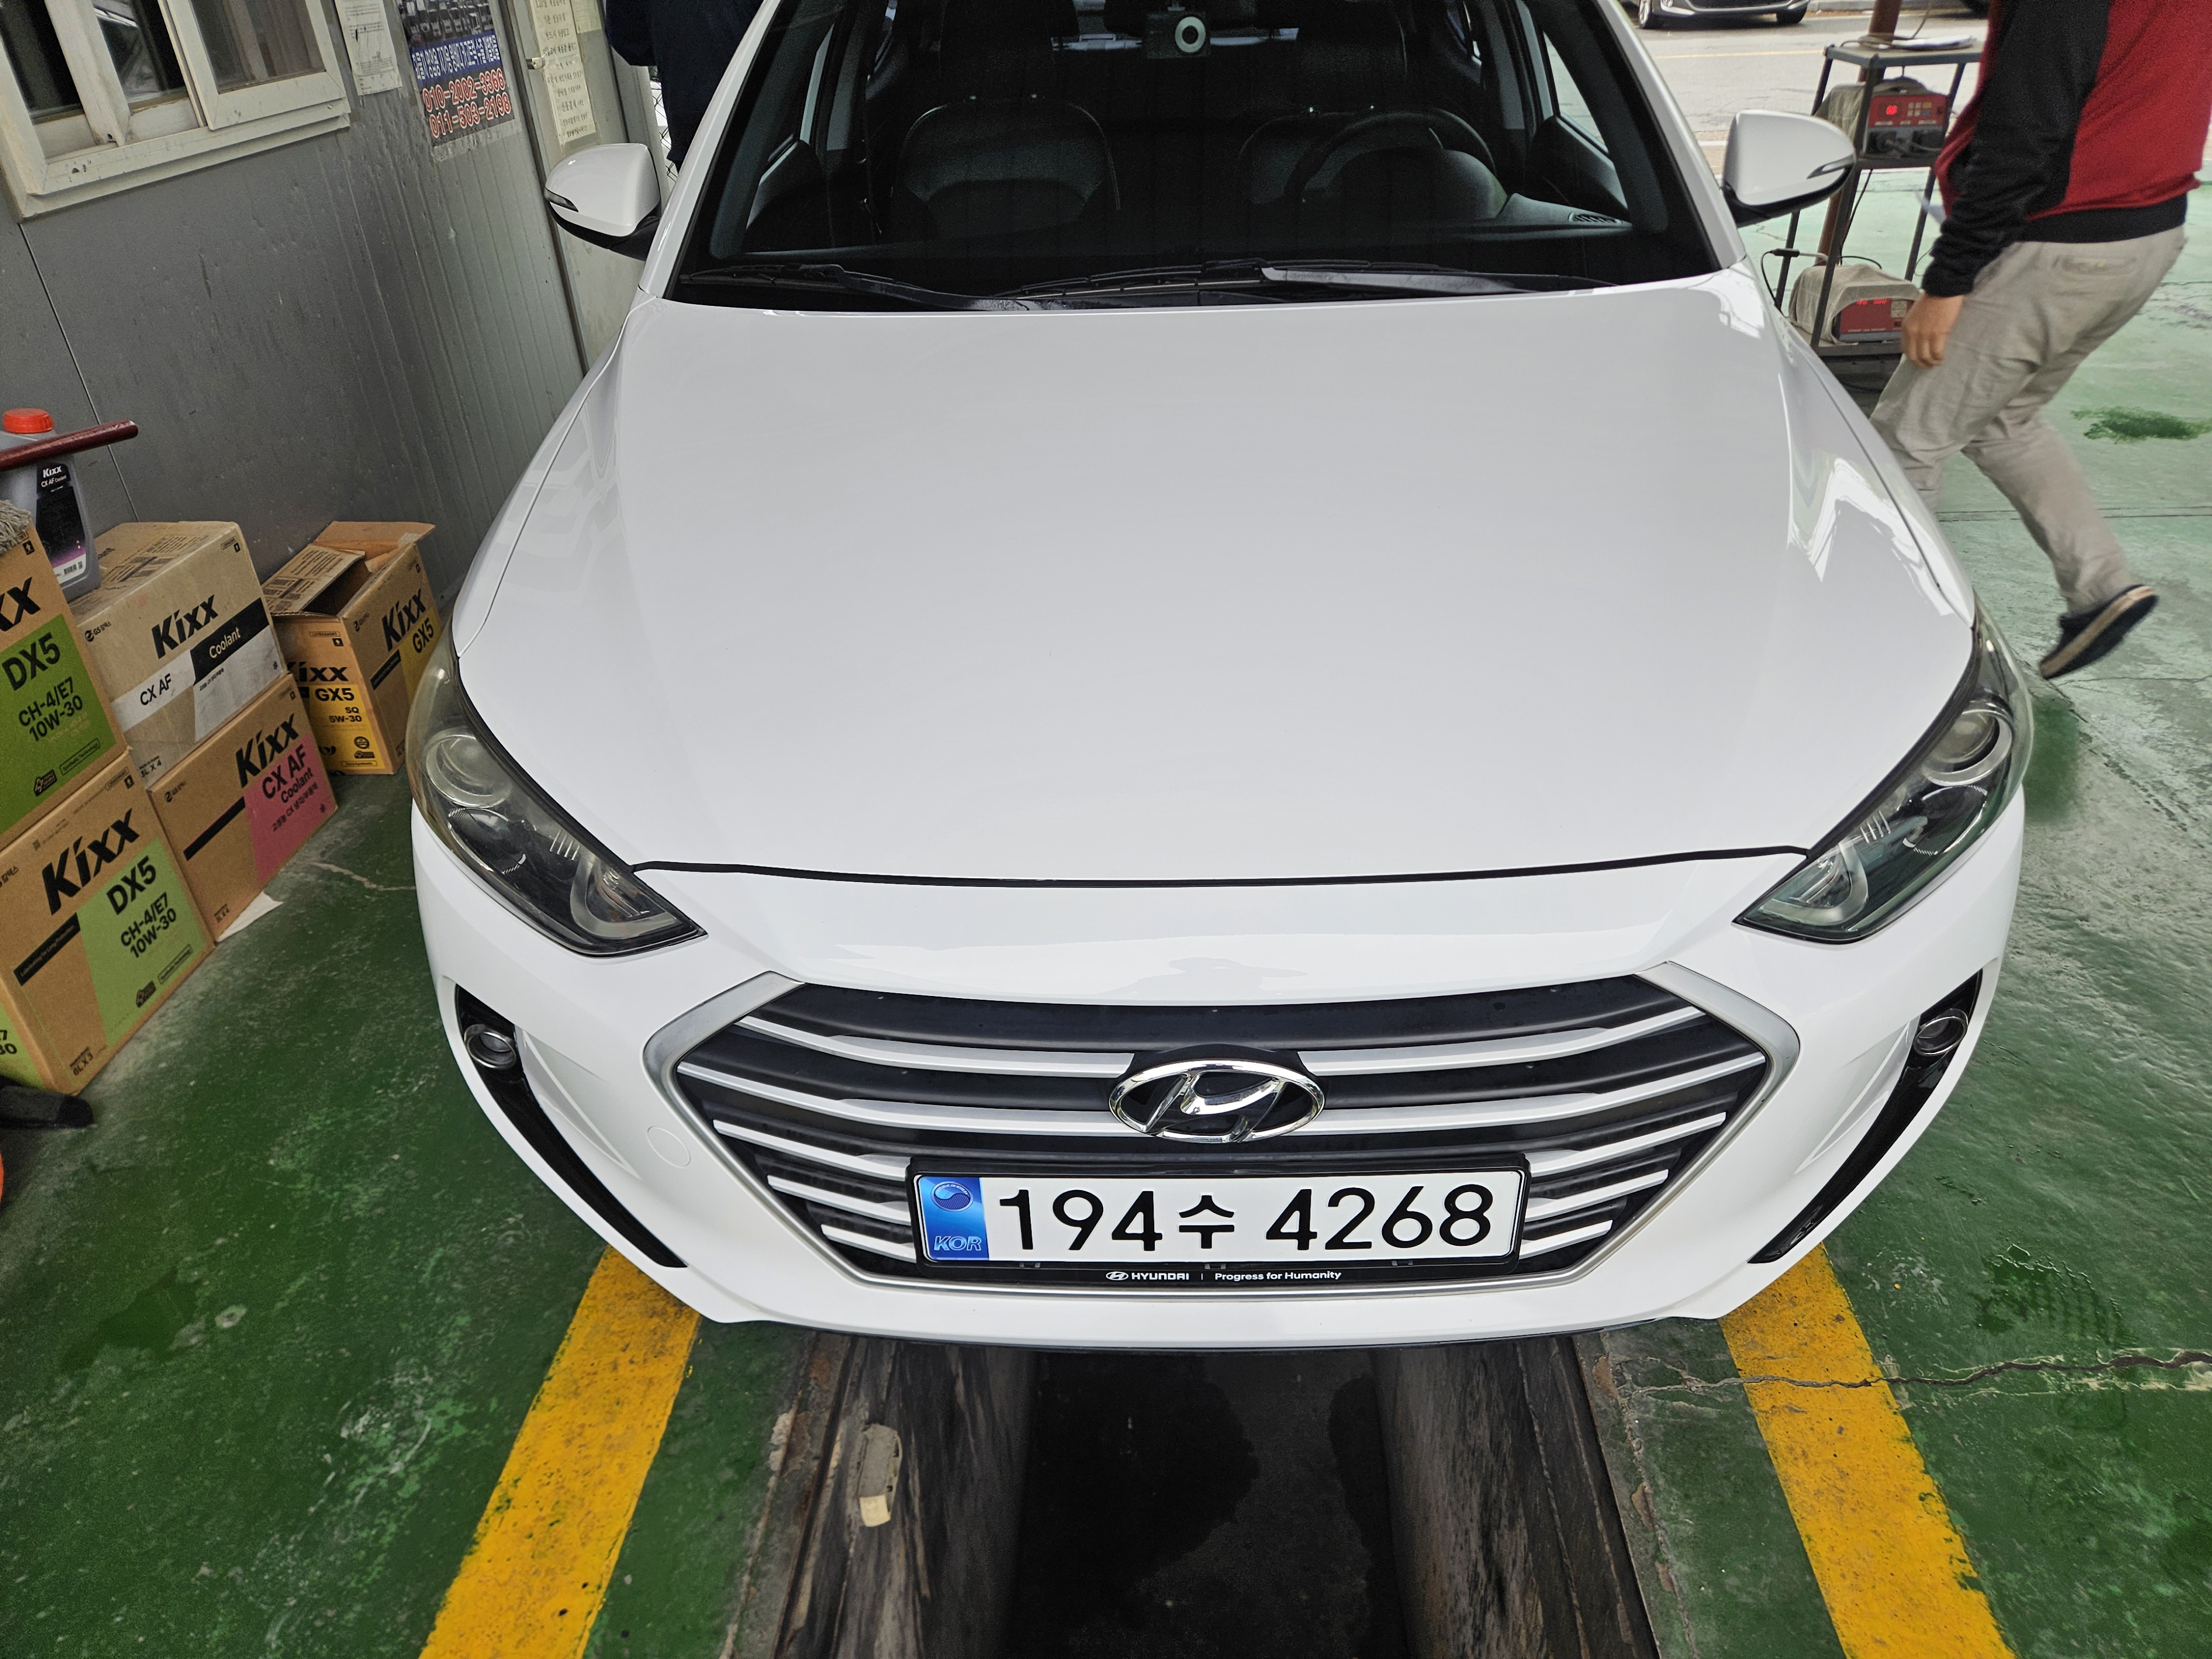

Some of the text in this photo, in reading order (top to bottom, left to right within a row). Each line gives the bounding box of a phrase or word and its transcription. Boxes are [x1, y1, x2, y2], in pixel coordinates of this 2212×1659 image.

[422, 67, 504, 112] 010-2002-3366
[429, 92, 511, 138] 011-503-2198
[43, 466, 62, 478] Kixx
[93, 627, 101, 635] GS
[151, 594, 218, 660] Kixx
[209, 627, 241, 658] Coolant
[382, 588, 426, 652] Kixx
[413, 617, 434, 654] GX5
[2, 632, 60, 691] DX5
[287, 661, 349, 682] ixx
[19, 676, 74, 727] CH-4/E7
[140, 673, 171, 706] CX AF
[315, 688, 354, 701] GX5
[29, 693, 83, 742] 10W-30
[235, 713, 299, 789] Kixx
[262, 744, 306, 799] CX AF
[281, 767, 314, 804] Coolant
[42, 808, 139, 916] Kixx
[106, 855, 156, 915] DX5
[121, 891, 168, 947] CH-4/E7
[130, 908, 176, 958] 10W-30
[1000, 1184, 1493, 1251] 194수 4268
[934, 1236, 982, 1251] KOR
[1215, 1272, 1264, 1281] Progress
[1285, 1271, 1342, 1281] Humanity
